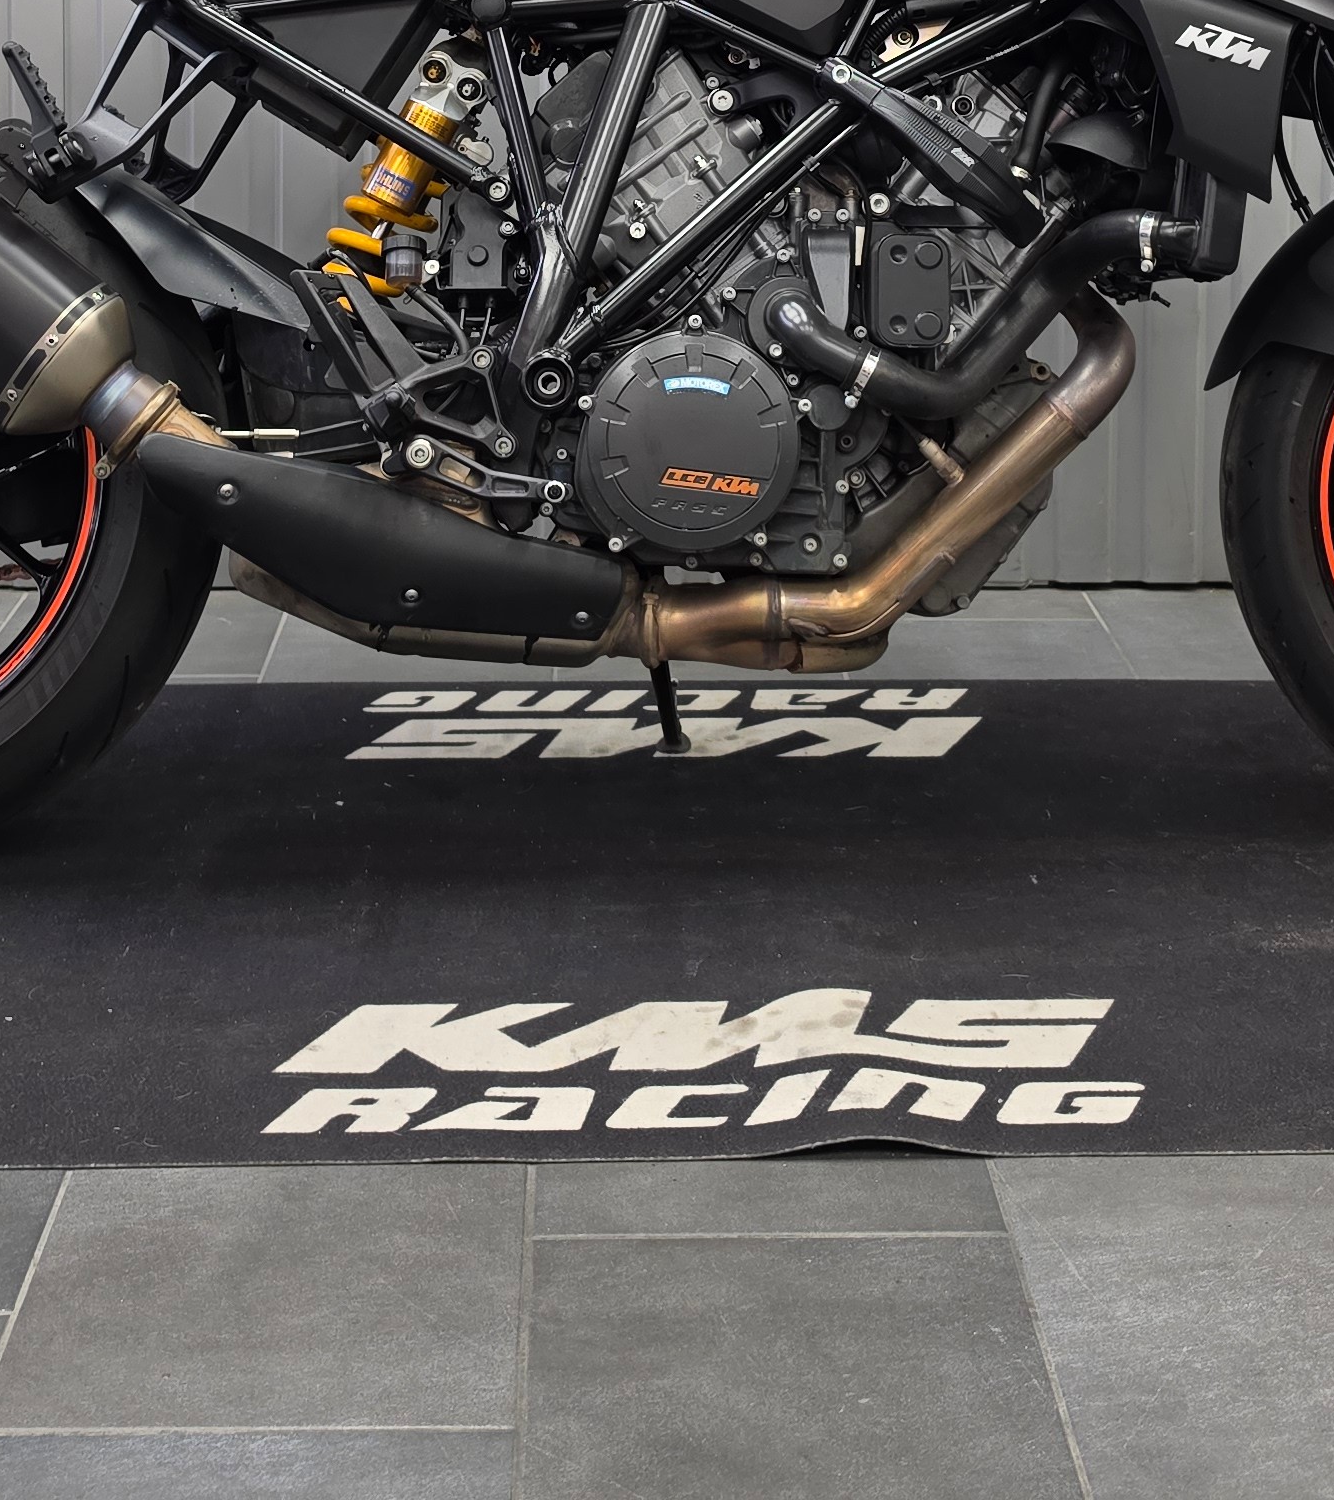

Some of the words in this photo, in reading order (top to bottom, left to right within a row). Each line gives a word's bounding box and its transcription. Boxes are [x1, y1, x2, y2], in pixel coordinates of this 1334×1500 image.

[1174, 23, 1271, 71] KTM
[680, 378, 727, 394] MOTOREX
[712, 477, 760, 496] KTM
[362, 687, 968, 713] RACING
[345, 715, 982, 760] KMS
[271, 987, 1115, 1073] KMS
[261, 1067, 1146, 1135] RACING
